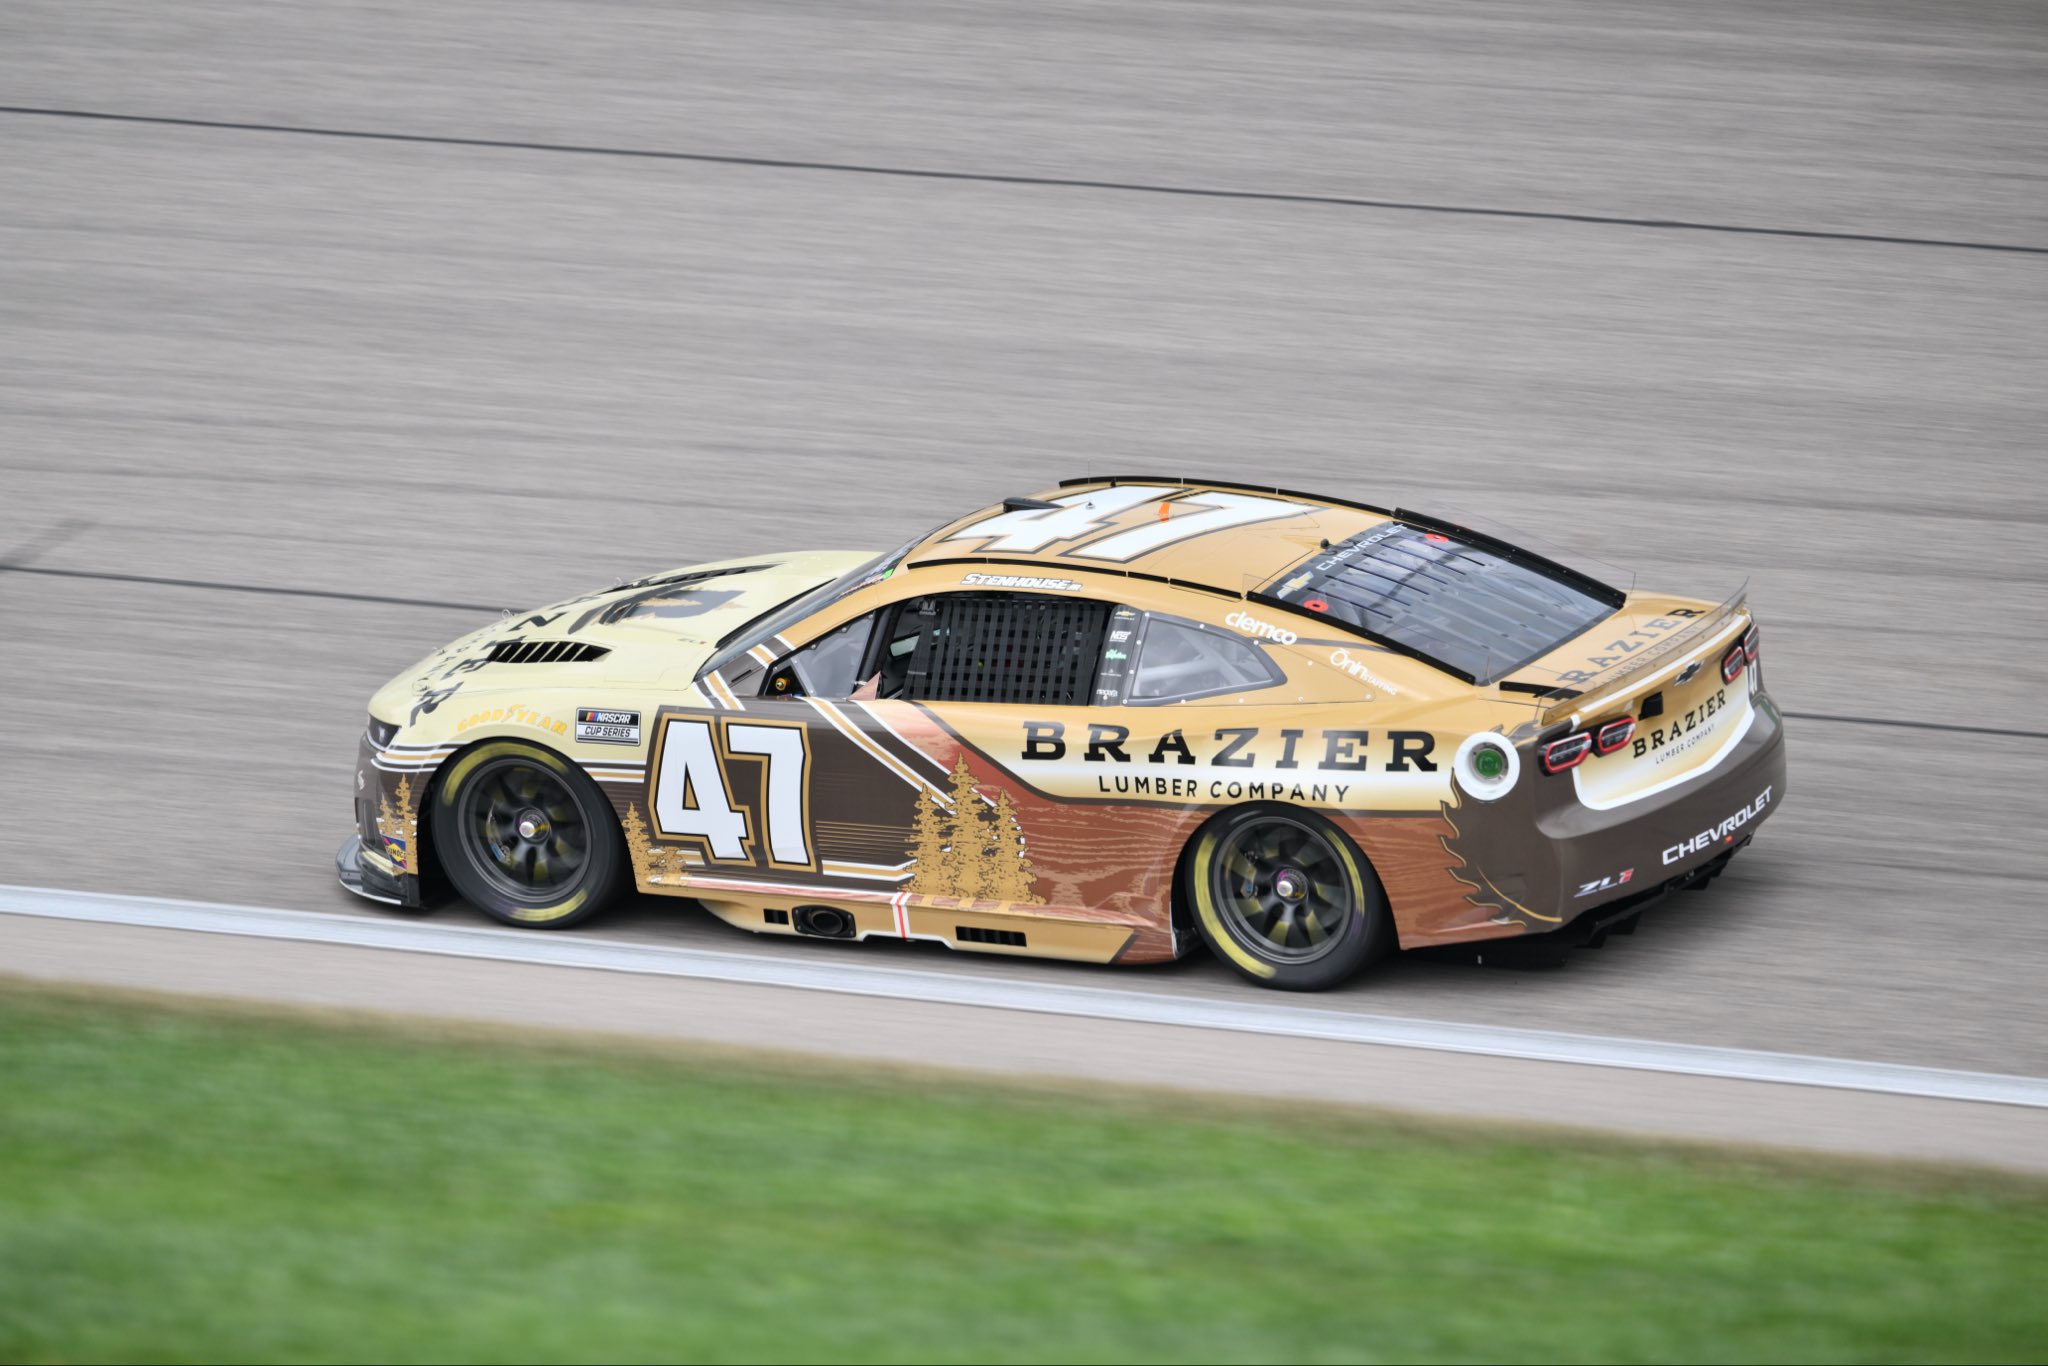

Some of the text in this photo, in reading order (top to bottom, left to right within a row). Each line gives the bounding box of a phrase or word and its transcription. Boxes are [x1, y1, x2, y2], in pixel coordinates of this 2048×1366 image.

[940, 485, 1326, 563] 47
[1315, 523, 1407, 571] CHEVROLET
[960, 573, 1072, 591] STENHOUSE
[1556, 608, 1706, 685] RAZIER
[456, 703, 568, 736] GOODYEAR
[584, 725, 632, 738] CUP SERIES
[596, 711, 632, 725] NASCAR
[1631, 688, 1727, 759] BRAZIER
[1021, 720, 1438, 773] BRAZIER
[649, 713, 816, 873] 47
[1098, 775, 1351, 803] LUMBER COMPANY
[1662, 785, 1773, 866] CHEVROLET
[1573, 867, 1635, 898] ZL1
